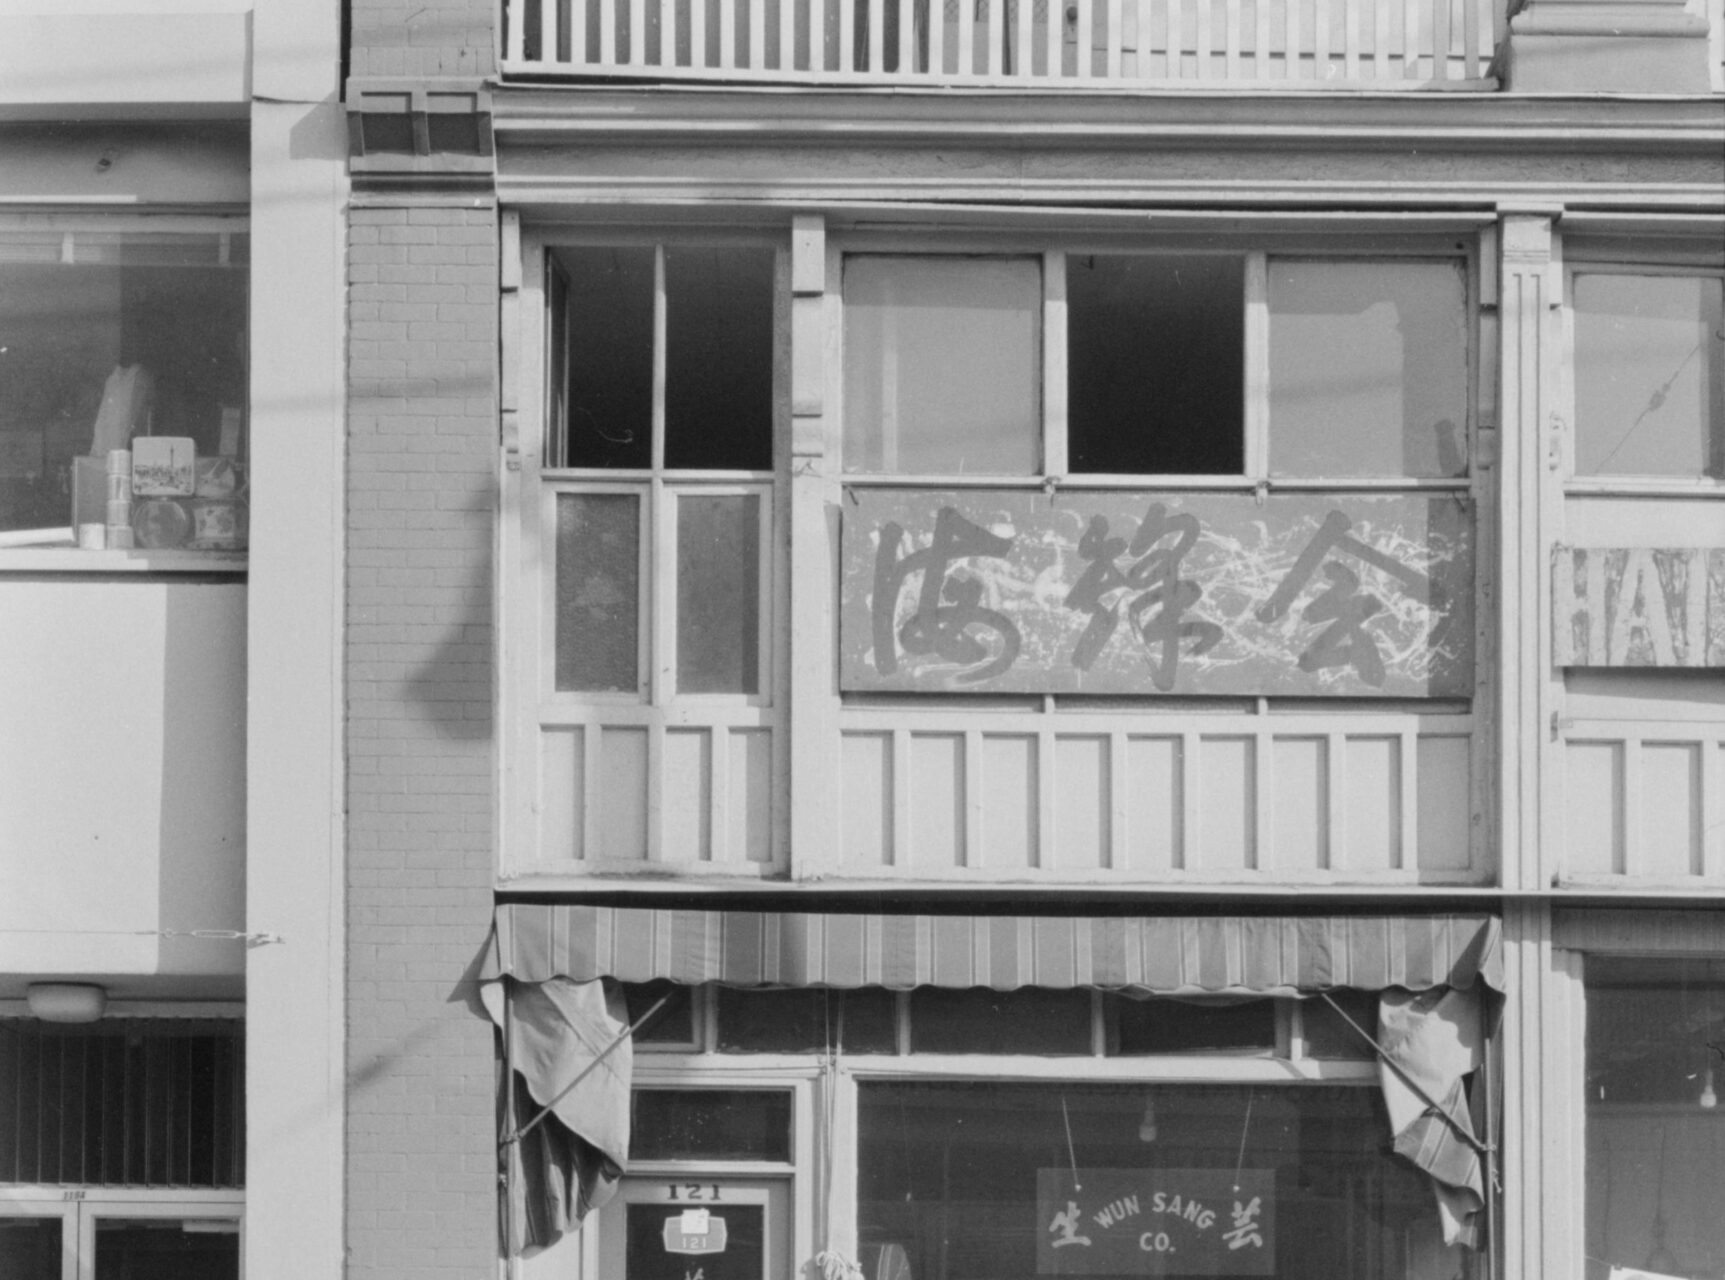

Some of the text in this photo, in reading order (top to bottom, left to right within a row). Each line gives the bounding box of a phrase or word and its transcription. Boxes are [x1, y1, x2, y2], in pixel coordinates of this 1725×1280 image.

[667, 1184, 721, 1200] 121
[1093, 1192, 1216, 1229] WUN SANG
[681, 1237, 707, 1249] 121
[1139, 1232, 1176, 1254] CO.
